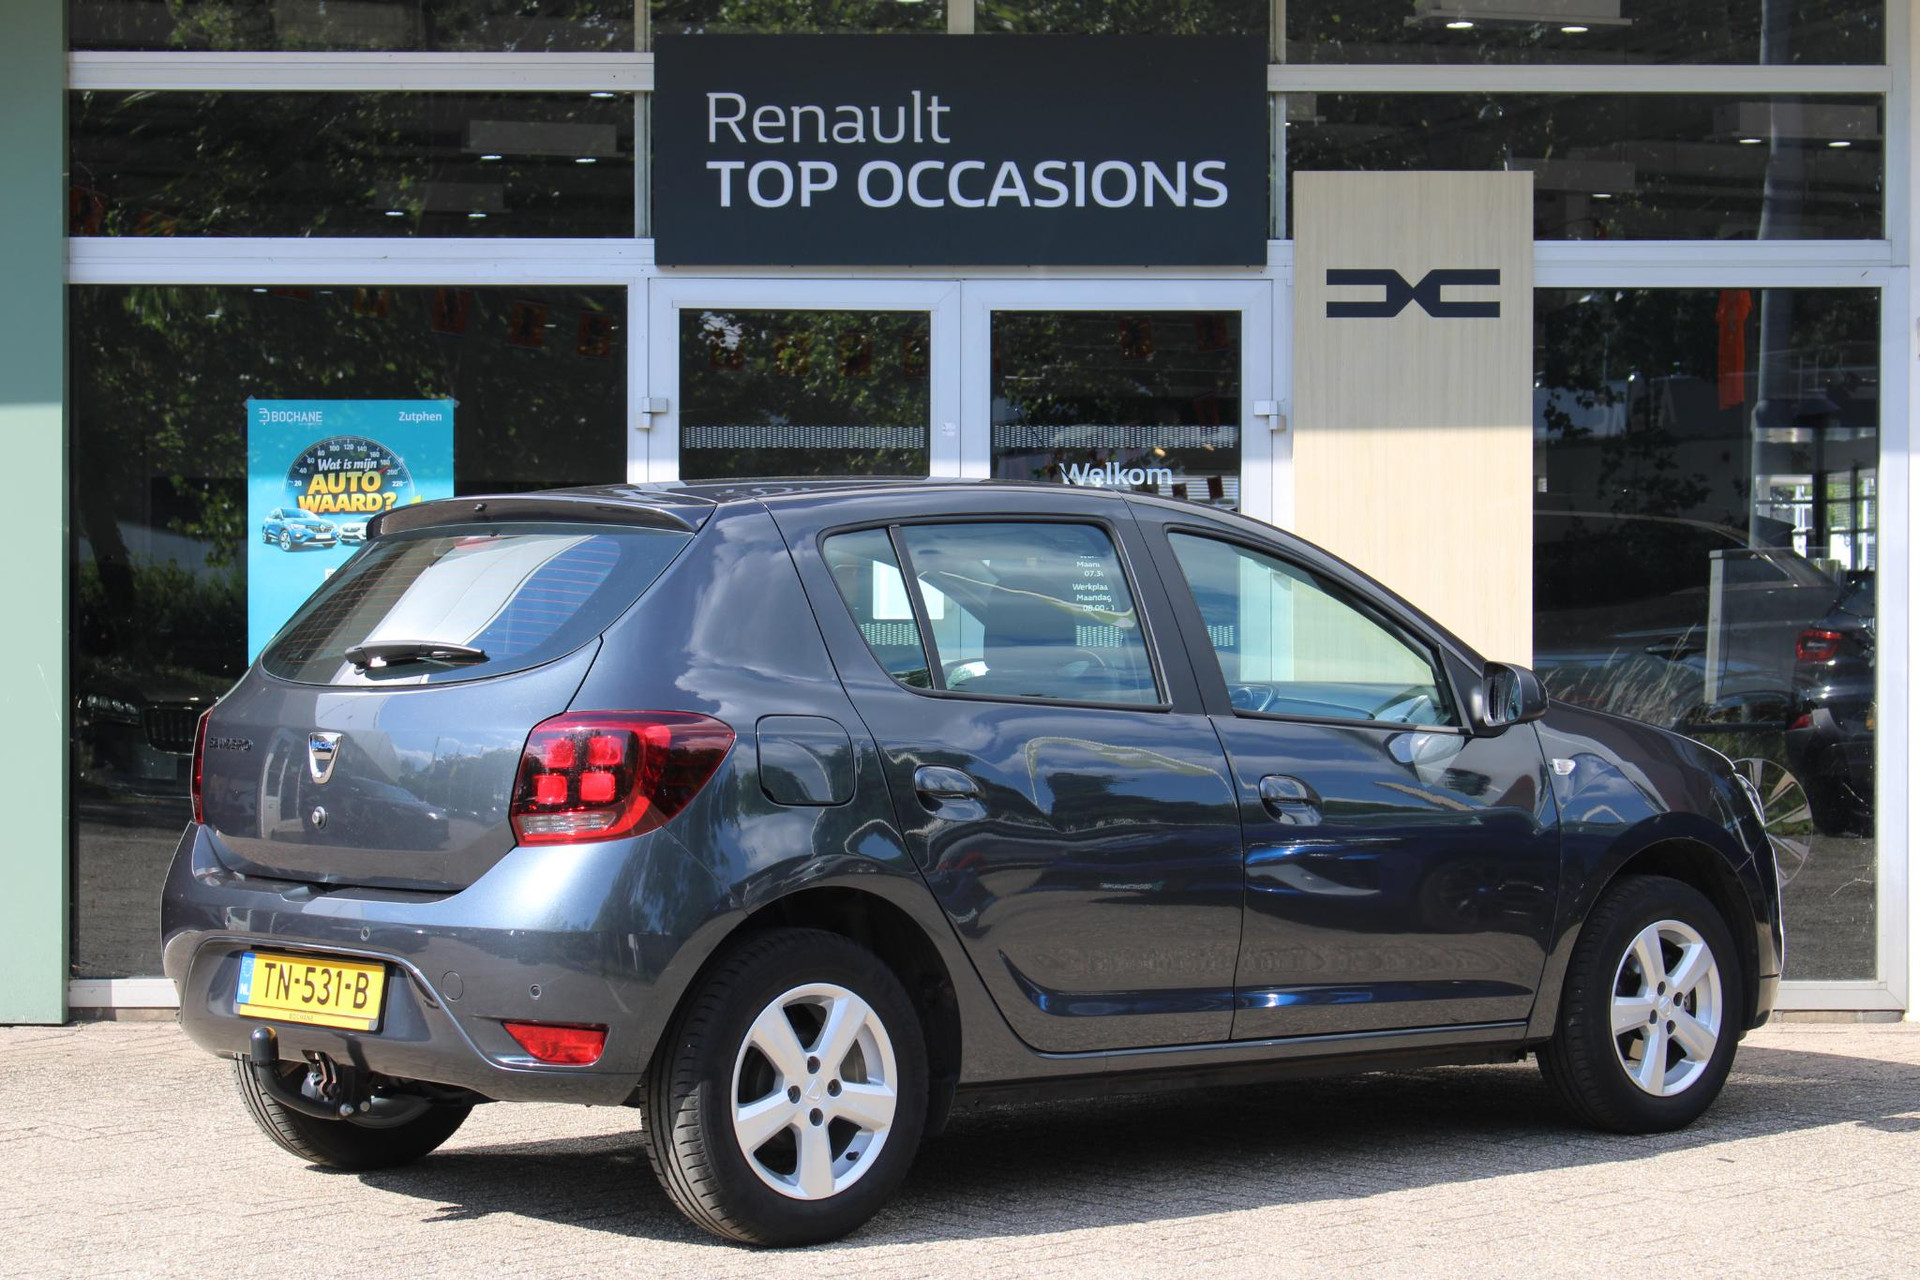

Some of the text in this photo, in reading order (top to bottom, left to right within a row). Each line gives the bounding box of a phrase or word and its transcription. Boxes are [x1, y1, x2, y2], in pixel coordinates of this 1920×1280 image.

[706, 90, 951, 144] Renault
[706, 160, 1228, 208] TOP OCCASIONS
[271, 411, 323, 423] BOCHANE
[398, 411, 442, 424] Zutphen
[318, 458, 377, 472] Wat is mijn
[1059, 462, 1173, 486] Welkom
[307, 471, 381, 494] AUTO
[298, 492, 397, 513] WAARD?
[240, 983, 249, 995] NL
[265, 963, 369, 1009] TN-531-B
